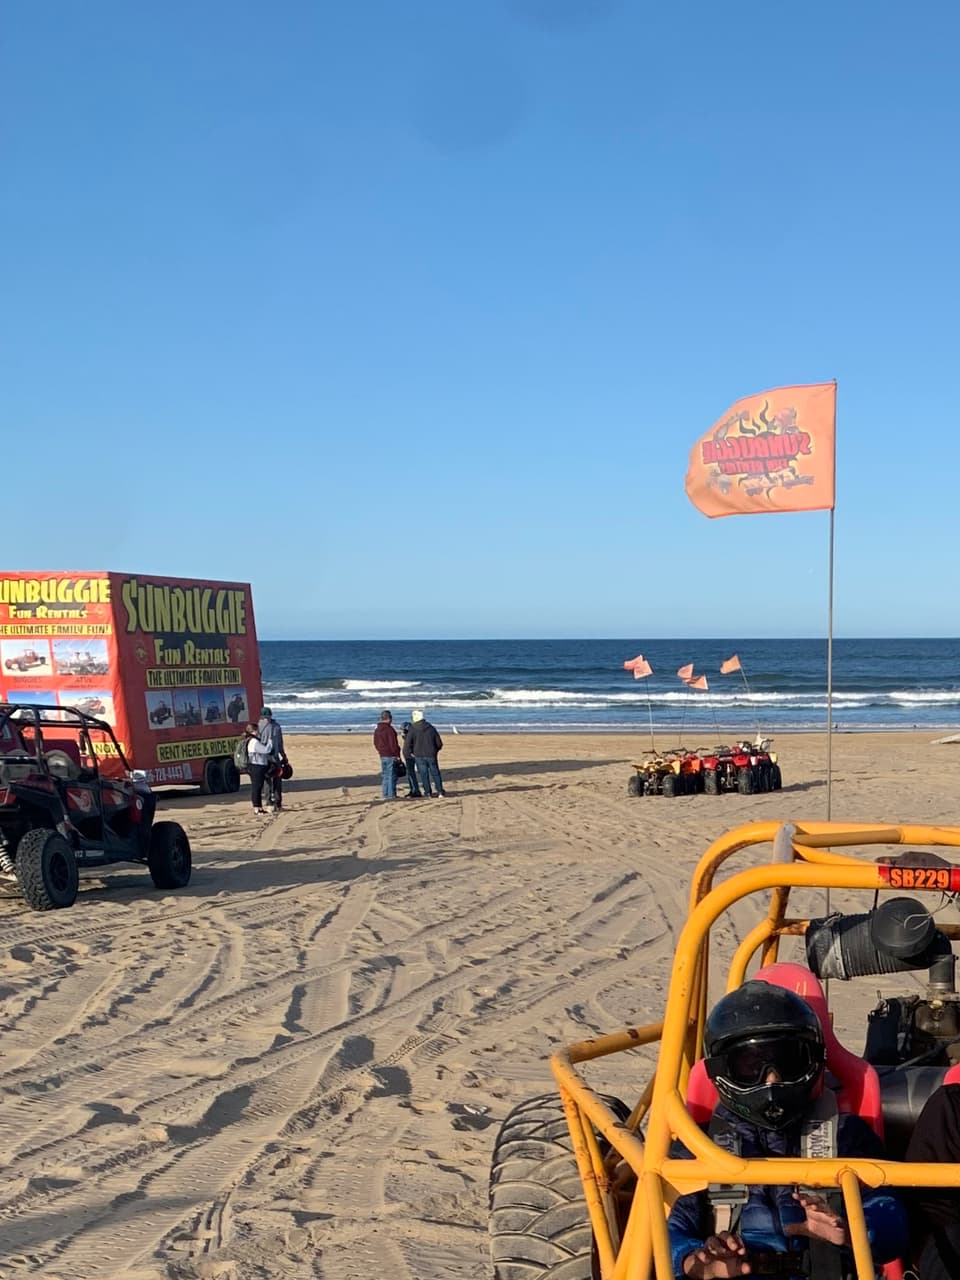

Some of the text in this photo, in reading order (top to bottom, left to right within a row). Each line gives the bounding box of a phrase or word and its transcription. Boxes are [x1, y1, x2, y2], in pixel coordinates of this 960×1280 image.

[0, 578, 110, 603] UNBUGGIE
[9, 605, 88, 618] FUN RENTALS
[122, 579, 246, 634] SUNBUGGIE
[0, 625, 8, 634] HE
[10, 625, 48, 634] ULTIMATE
[51, 625, 83, 634] FAMILY
[154, 639, 230, 665] FUN RENTALS
[148, 670, 162, 686] THE
[164, 670, 198, 685] ULTIMATE
[159, 738, 240, 761] RENT HERE & RIDE NO
[890, 868, 950, 889] SB229
[809, 1134, 823, 1158] ROW
